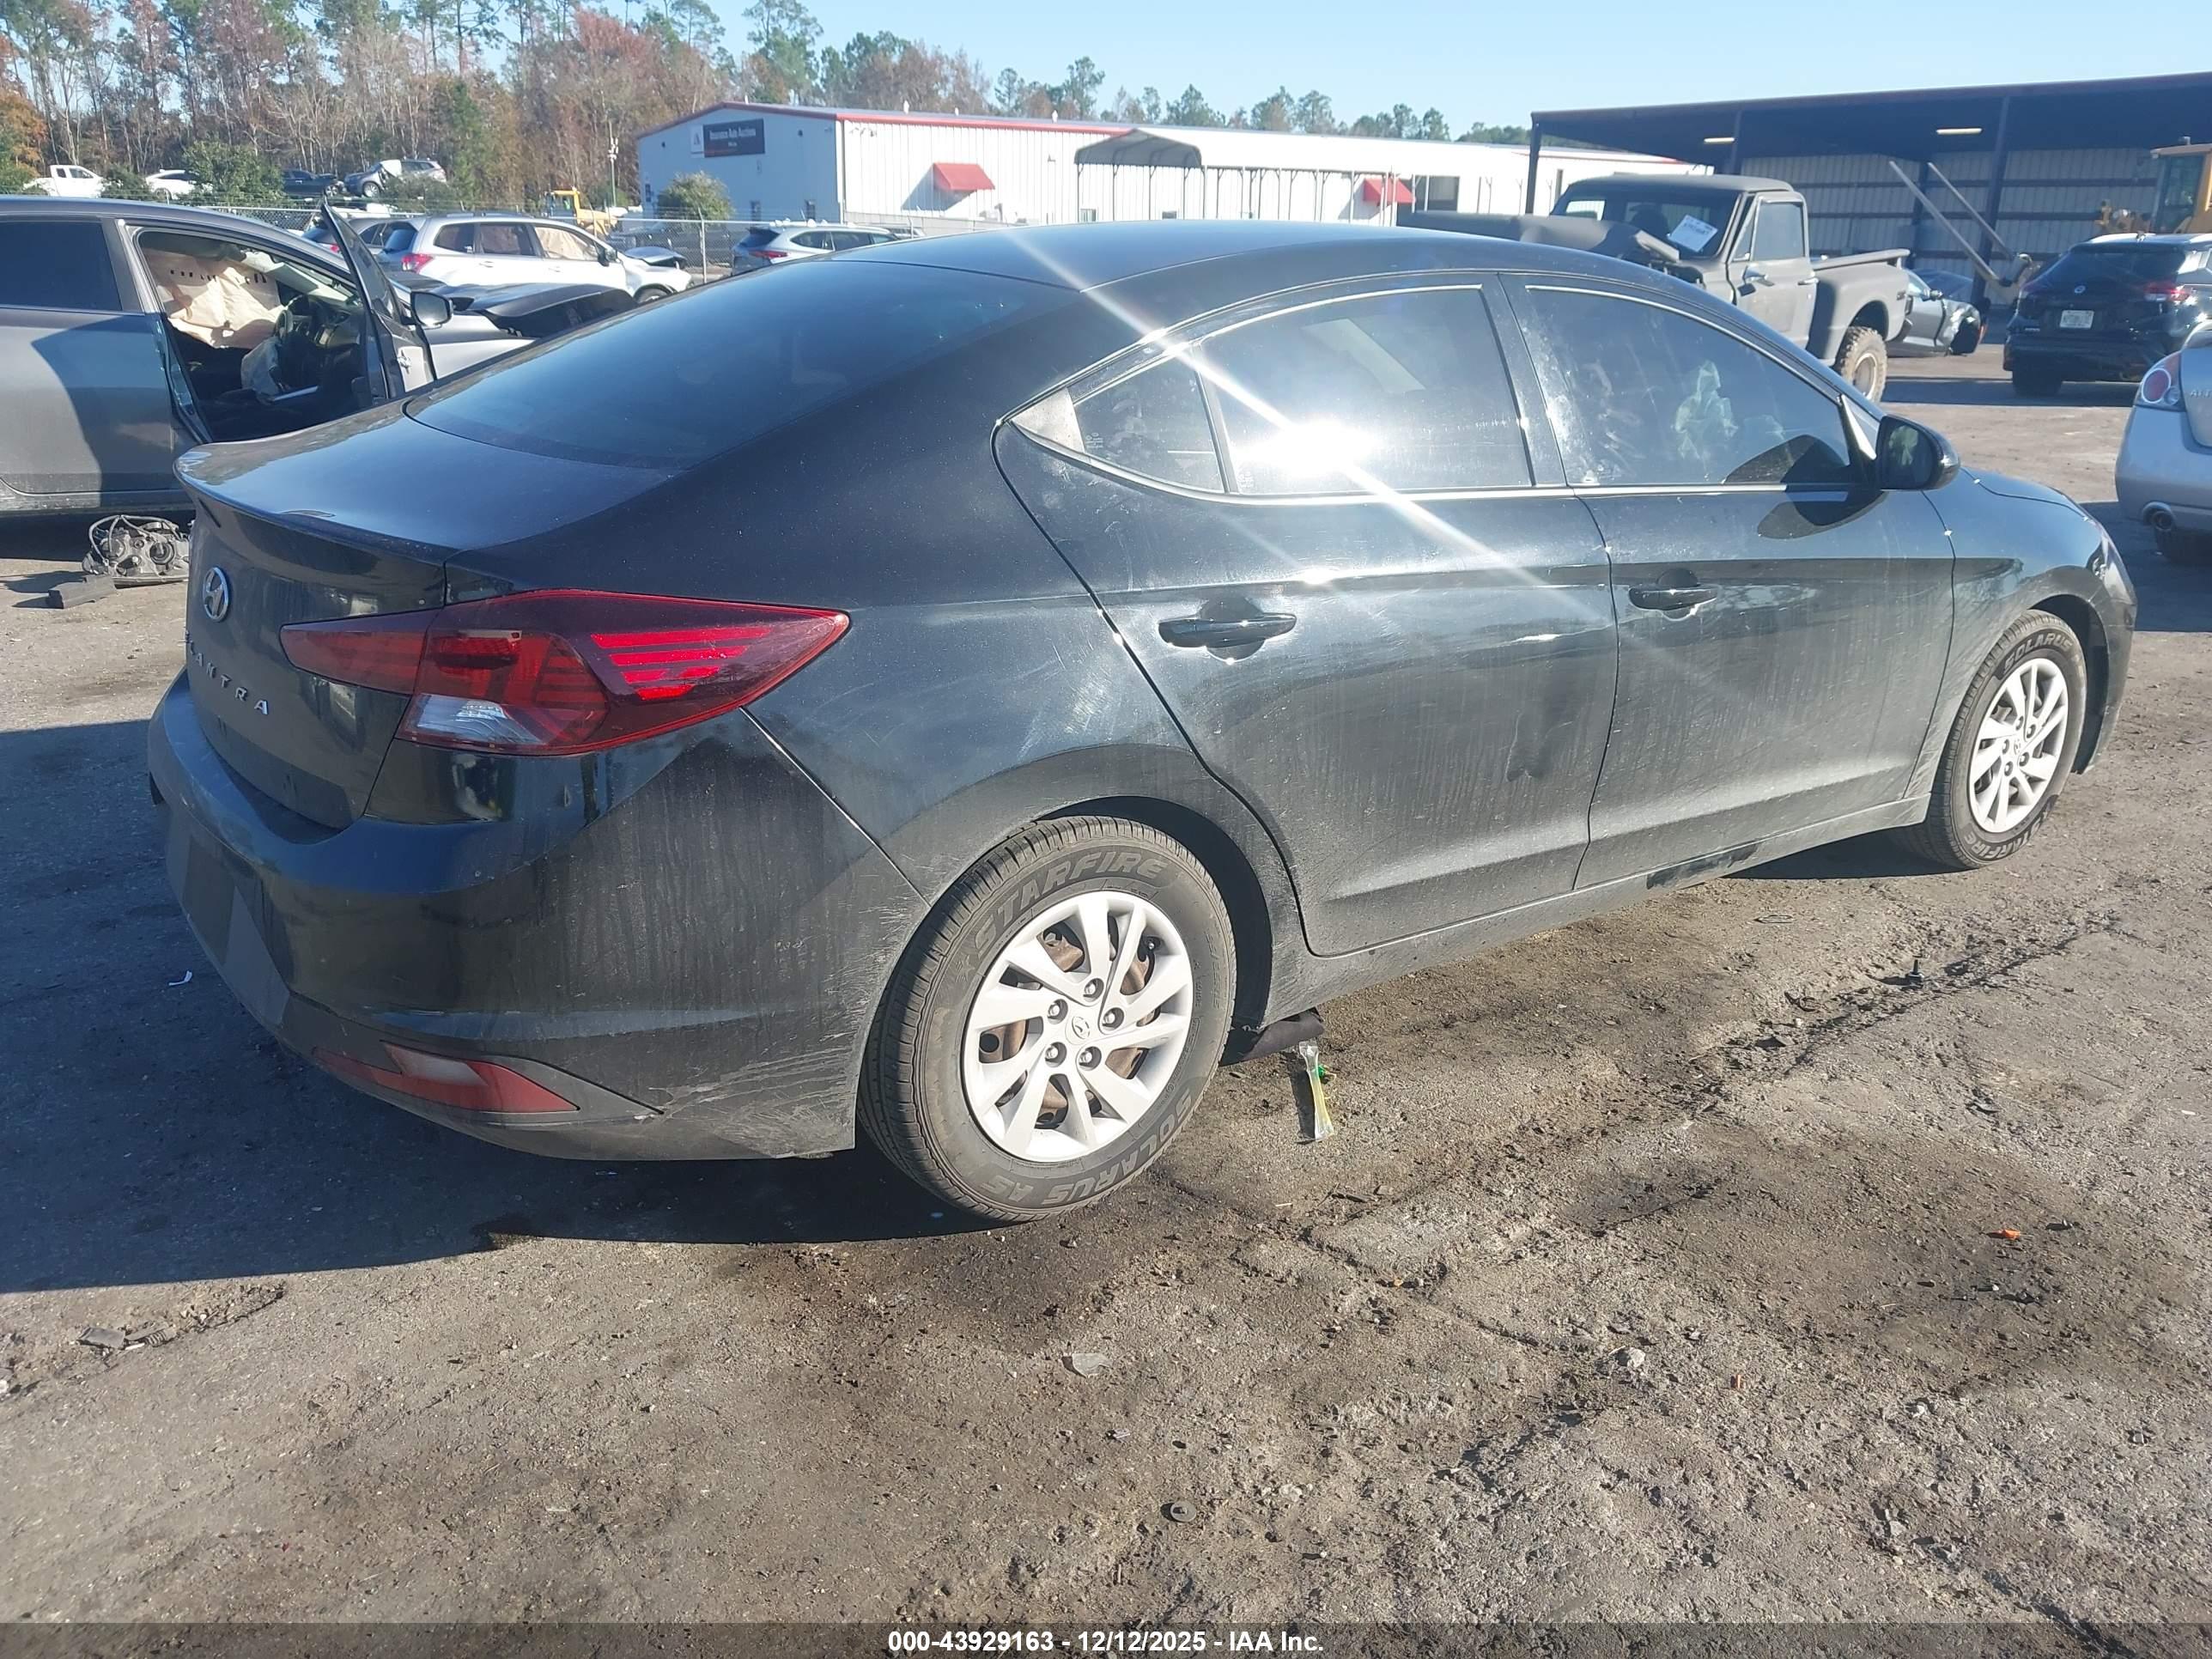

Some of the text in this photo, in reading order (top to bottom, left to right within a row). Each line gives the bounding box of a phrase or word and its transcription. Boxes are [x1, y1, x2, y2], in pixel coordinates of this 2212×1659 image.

[2003, 633, 2073, 675] SOLARUS
[974, 851, 1169, 959] STARFIRE
[1042, 1088, 1192, 1204] SOLARUS
